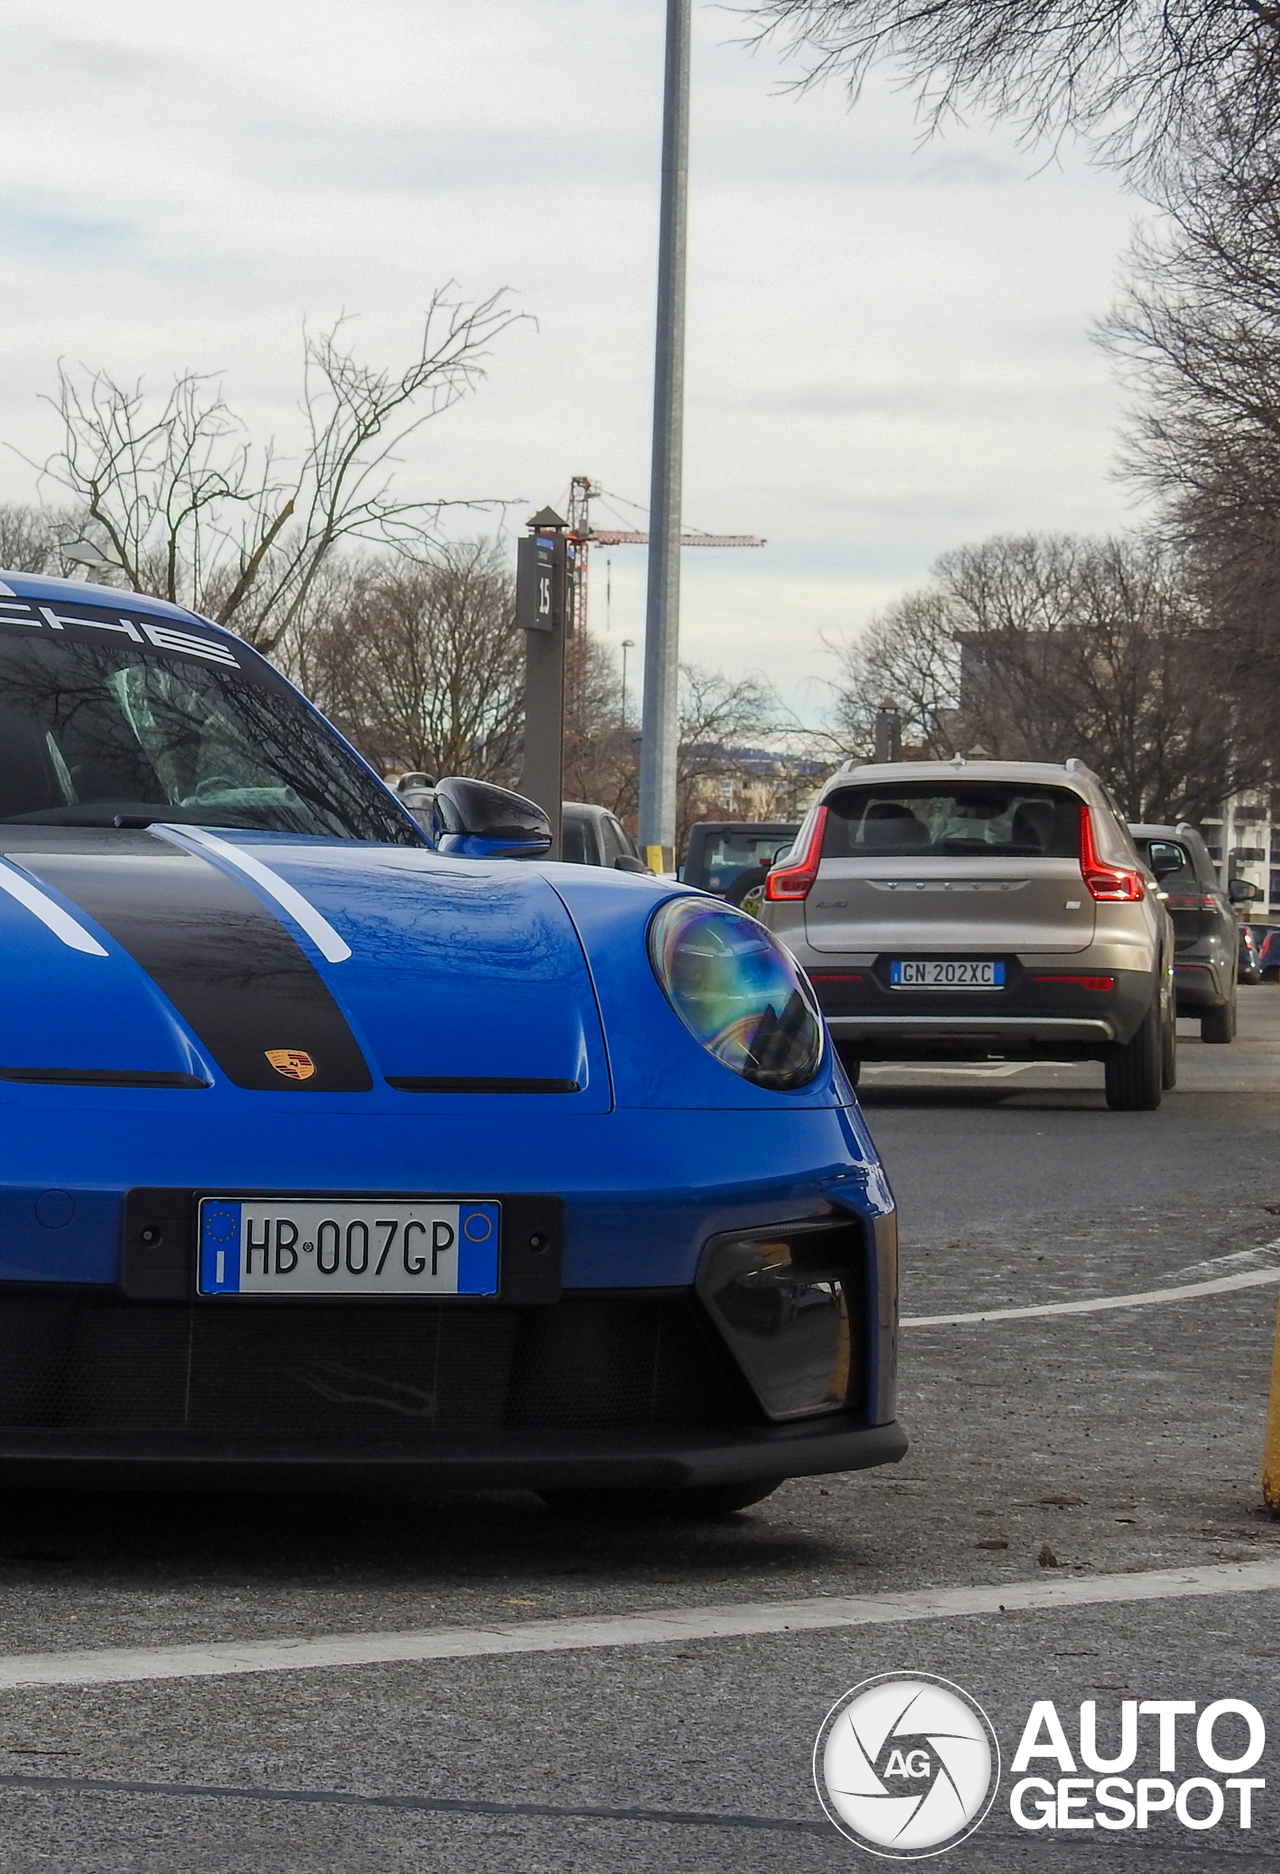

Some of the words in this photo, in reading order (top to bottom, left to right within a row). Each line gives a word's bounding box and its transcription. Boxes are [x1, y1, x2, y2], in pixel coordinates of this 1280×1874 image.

[903, 964, 926, 982] GN
[933, 964, 992, 982] 202XC
[245, 1217, 299, 1275] HB
[316, 1219, 455, 1276] 007GP
